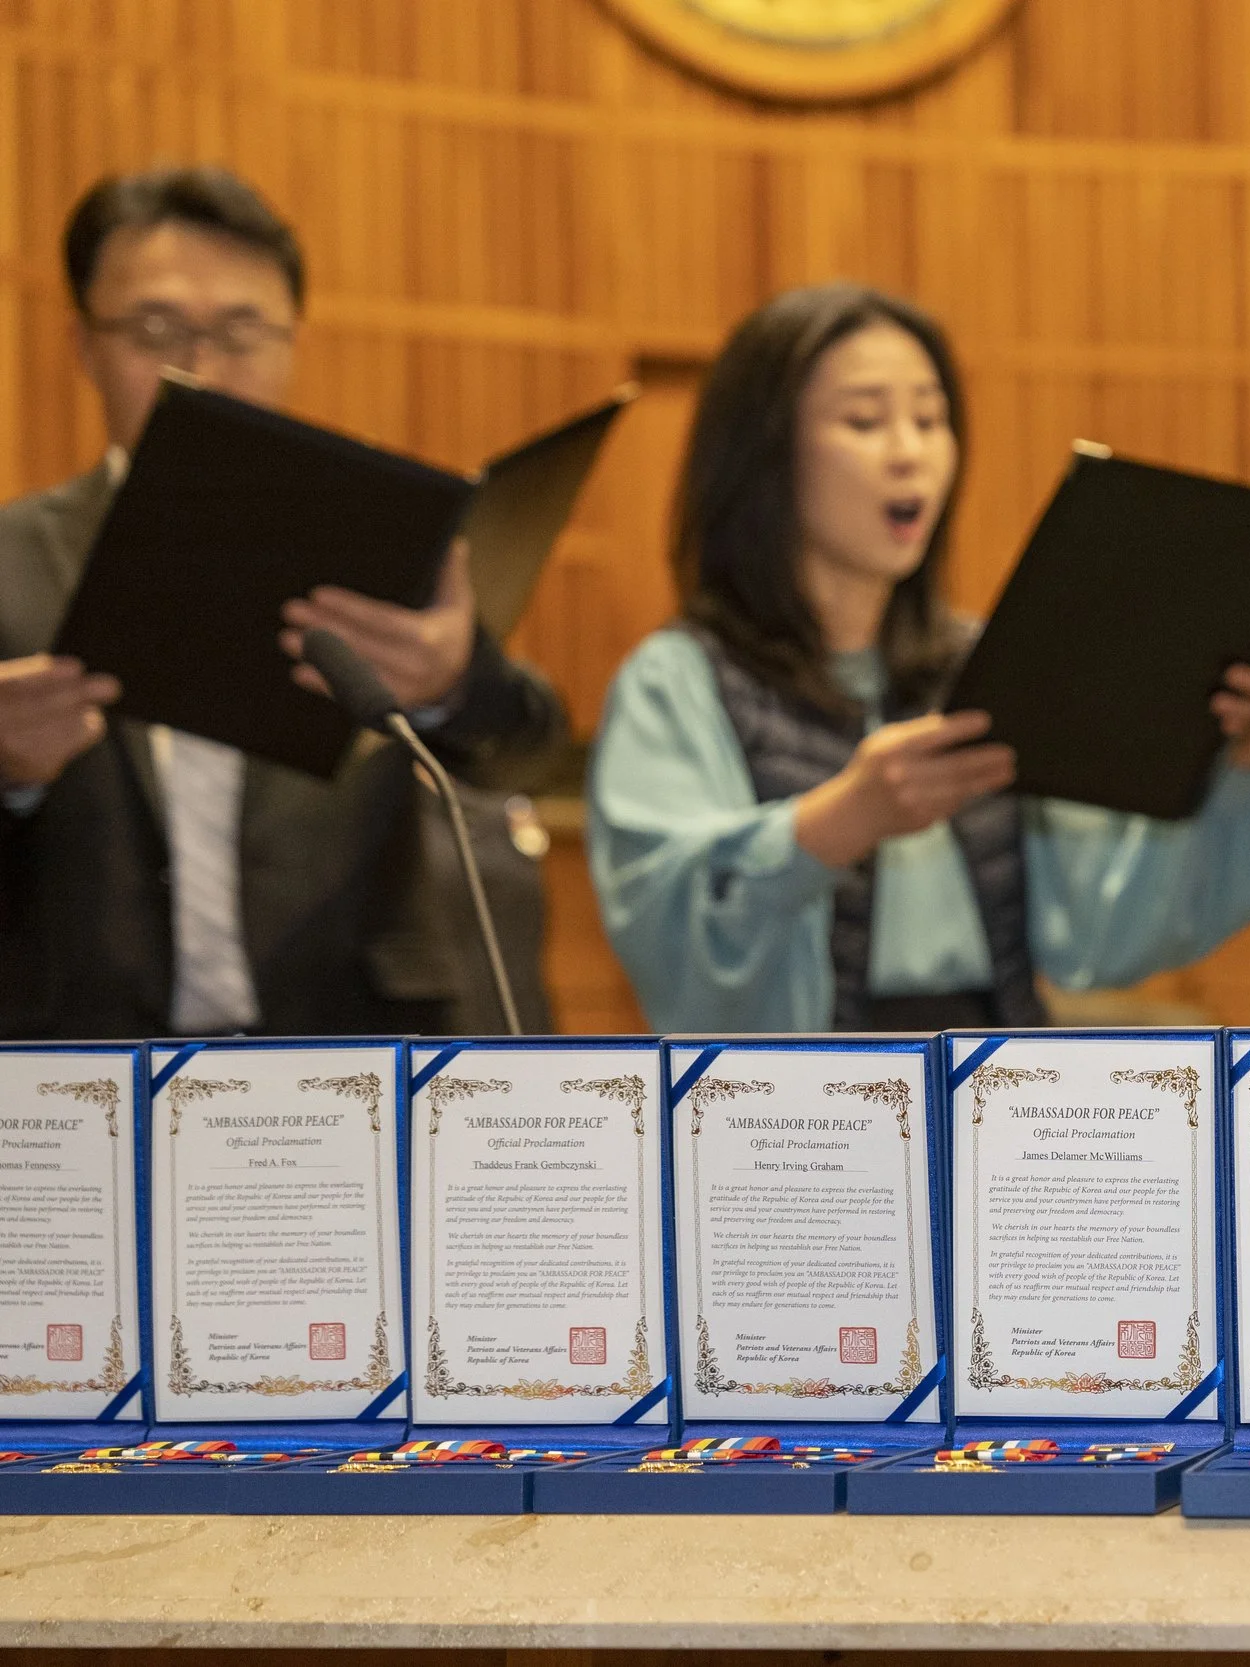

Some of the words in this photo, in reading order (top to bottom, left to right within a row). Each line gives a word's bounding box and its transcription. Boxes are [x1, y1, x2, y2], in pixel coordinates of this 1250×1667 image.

[1092, 1107, 1115, 1120] FOR
[22, 1118, 42, 1130] FOR
[281, 1115, 302, 1127] FOR
[544, 1117, 565, 1129] FOR
[807, 1118, 829, 1131] FOR
[1033, 1128, 1068, 1140] Official
[1071, 1128, 1135, 1139] Proclamation
[2, 1139, 61, 1149] Proclamation
[226, 1137, 259, 1149] Official
[262, 1136, 322, 1146] Proclamation
[488, 1138, 521, 1150] Official
[524, 1138, 584, 1148] Proclamation
[750, 1138, 784, 1151] Official
[787, 1139, 849, 1150] Proclamation
[1022, 1151, 1048, 1159] James
[1051, 1151, 1087, 1160] Delamer
[1090, 1151, 1142, 1161] McWilliams
[0, 1162, 22, 1170] omas
[25, 1160, 61, 1172] Fennessy
[249, 1159, 267, 1167] Fred
[472, 1160, 512, 1169] Thaddeus
[514, 1160, 538, 1169] Frank
[540, 1160, 596, 1170] Gembczynski
[754, 1161, 779, 1171] Henry
[782, 1161, 808, 1172] Irving
[810, 1162, 843, 1170] Graham
[1090, 1339, 1114, 1348] Affairs
[1011, 1348, 1041, 1357] Republic
[1044, 1348, 1053, 1358] of
